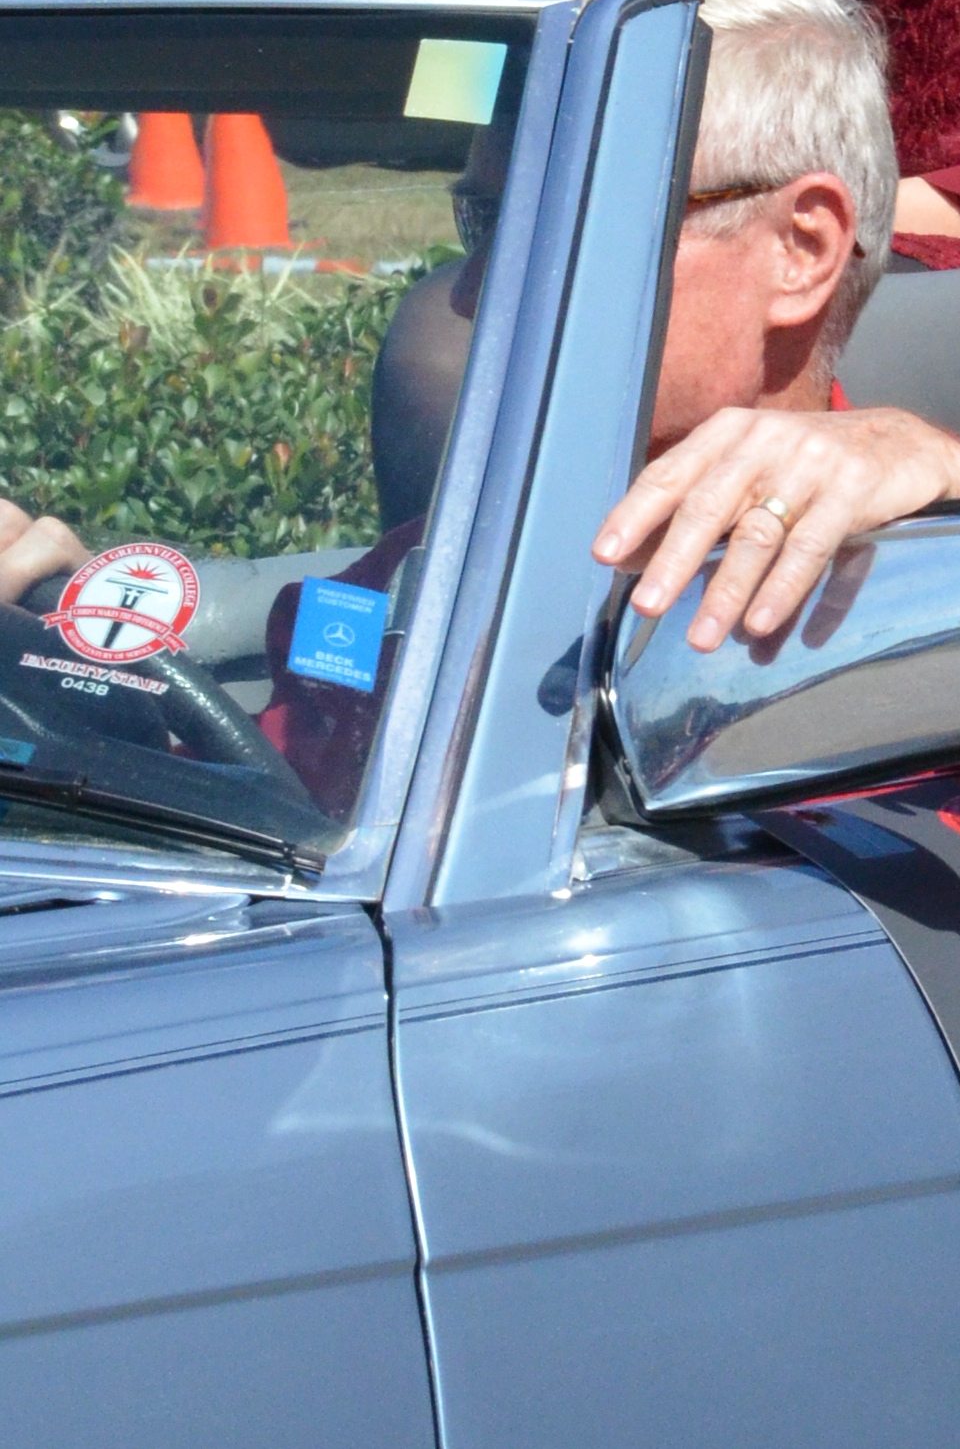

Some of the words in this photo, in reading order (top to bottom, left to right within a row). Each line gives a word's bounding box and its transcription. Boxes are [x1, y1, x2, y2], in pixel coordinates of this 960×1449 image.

[73, 557, 109, 586] NORTH
[109, 544, 184, 569] GREENVILLE
[181, 565, 197, 607] COLLEGE
[317, 596, 372, 613] CUSTOMER
[294, 656, 371, 682] MERCEDES
[315, 651, 354, 668] BECK
[19, 653, 169, 695] FACULTY/STAFF
[61, 678, 110, 696] 0438
